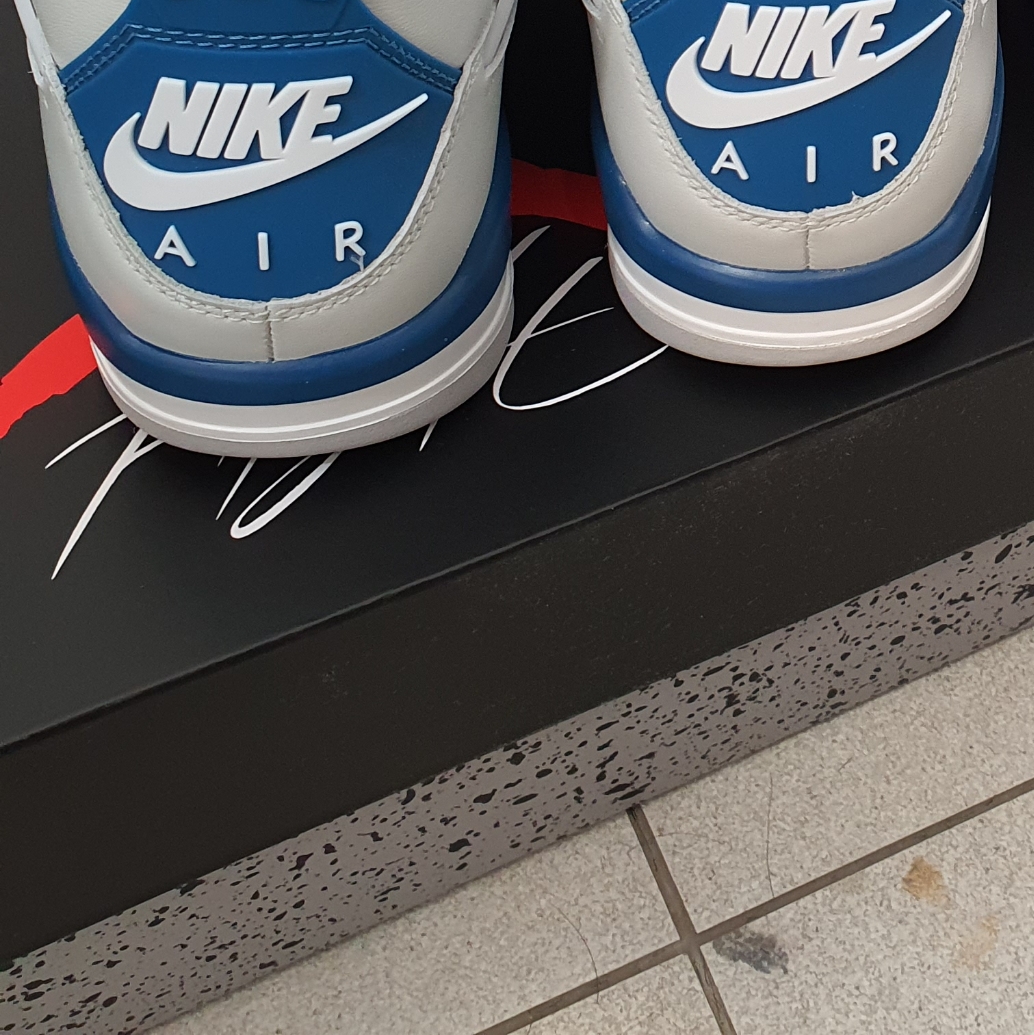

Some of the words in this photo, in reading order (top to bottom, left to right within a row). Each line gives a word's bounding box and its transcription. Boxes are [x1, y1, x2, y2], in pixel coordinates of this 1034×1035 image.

[137, 75, 353, 160] NIKE
[711, 131, 899, 183] AIR
[154, 220, 367, 271] AIR
